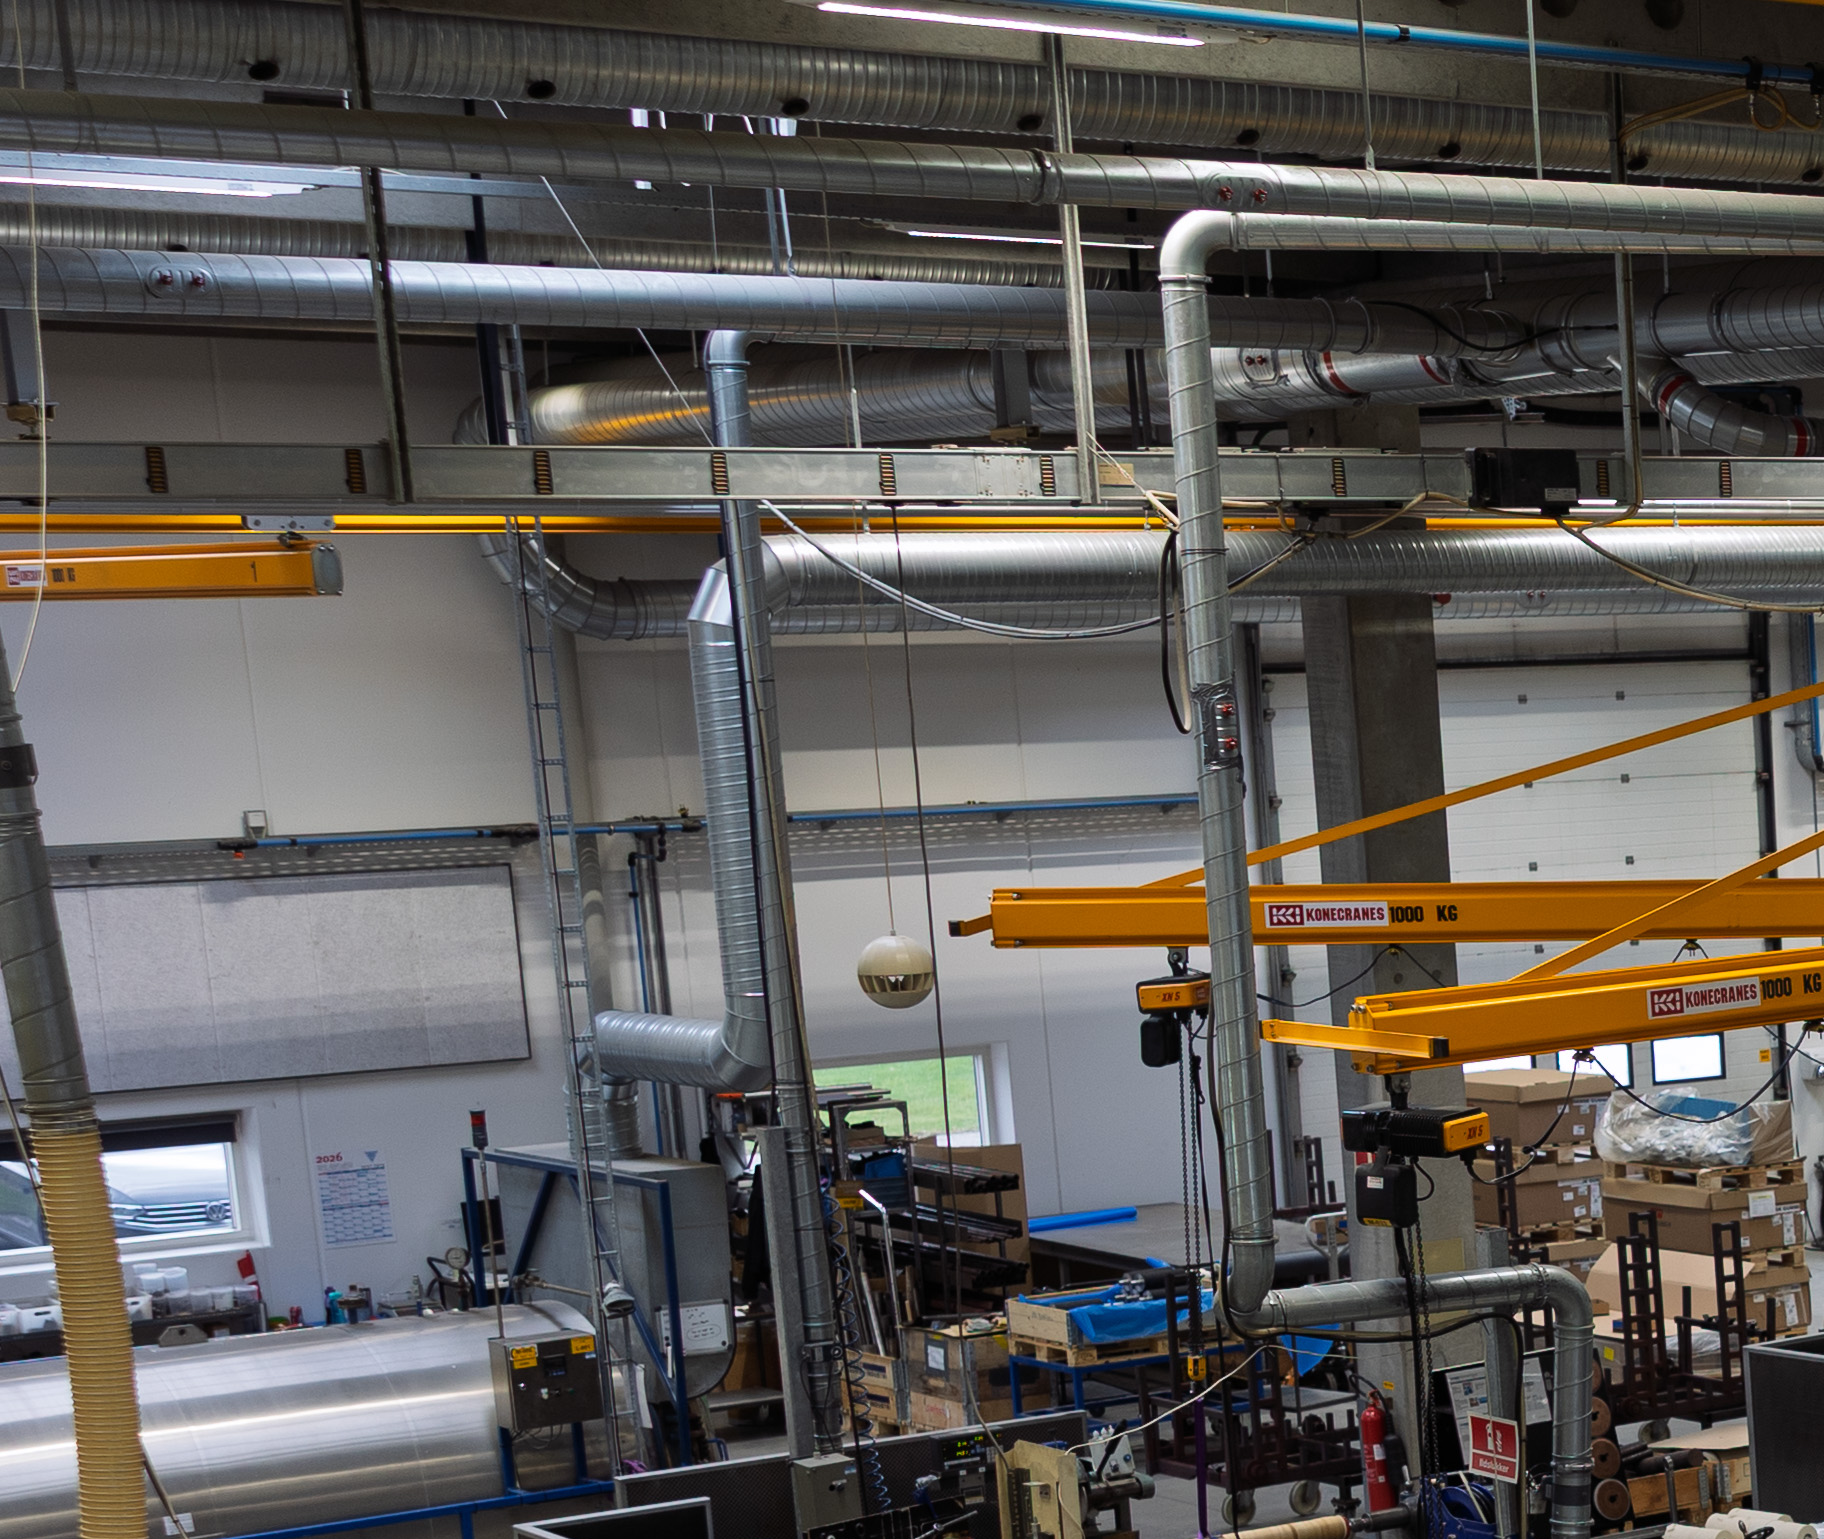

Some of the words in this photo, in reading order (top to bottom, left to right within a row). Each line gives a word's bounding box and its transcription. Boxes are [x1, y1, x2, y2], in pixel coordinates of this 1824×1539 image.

[1306, 906, 1385, 923] KONECRANES
[1389, 905, 1424, 924] 1000
[1436, 904, 1458, 922] KG
[1685, 982, 1758, 1009] KONECRANES
[1761, 976, 1793, 1001] 1000
[1803, 972, 1822, 995] KG
[316, 1152, 343, 1164] 2026
